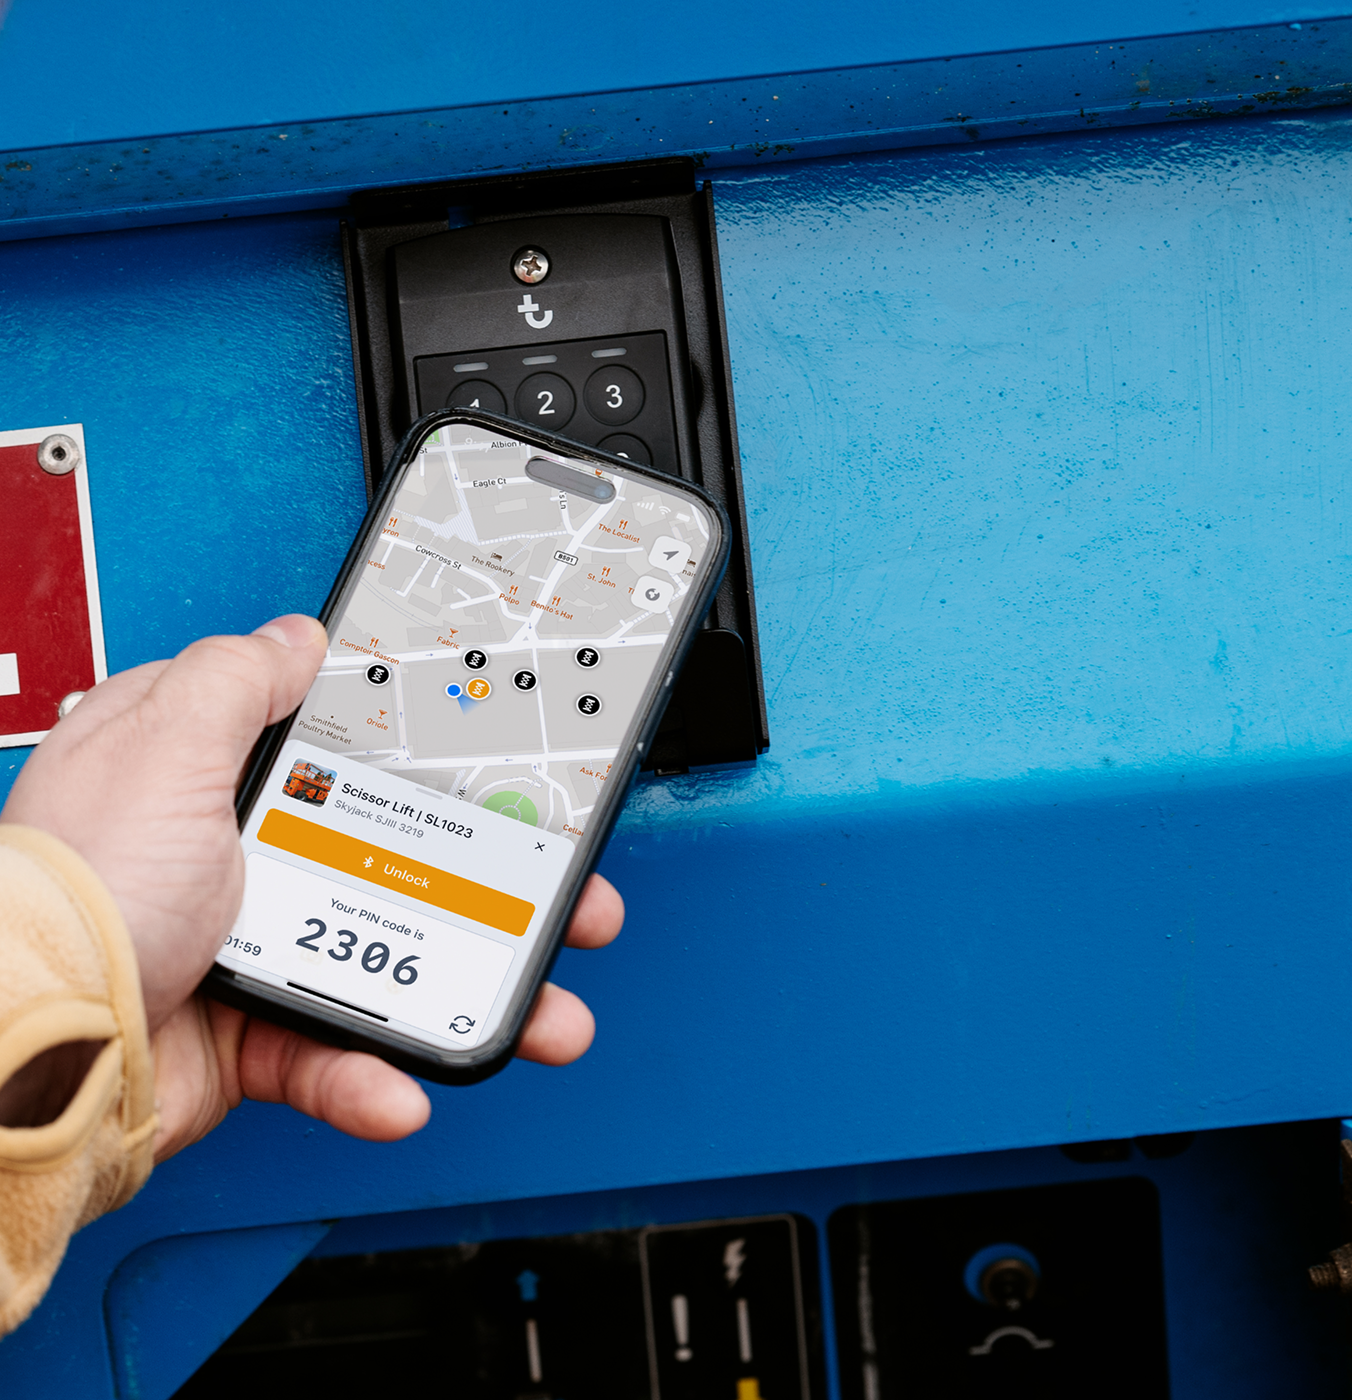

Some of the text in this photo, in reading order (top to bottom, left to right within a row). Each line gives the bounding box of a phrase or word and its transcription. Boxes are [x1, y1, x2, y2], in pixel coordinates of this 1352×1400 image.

[537, 384, 623, 415] 2 3
[491, 441, 517, 449] Albion
[473, 477, 507, 488] Eagle Ct
[598, 523, 640, 543] The Localist
[415, 544, 462, 570] Cowcross St
[471, 555, 515, 577] The Rookery
[587, 573, 616, 588] St. John
[499, 593, 520, 605] Polpo
[530, 600, 574, 620] Benito's Hat
[339, 638, 400, 665] Comptoir Gascon
[436, 636, 460, 650] Fabric
[298, 720, 352, 745] Poultry Market
[310, 714, 348, 733] Smithfield
[366, 717, 389, 731] Oriole
[579, 766, 593, 777] Ask
[334, 799, 373, 820] Skyjack
[398, 823, 425, 838] 3219
[341, 782, 390, 808] Scissor
[391, 801, 416, 818] Lift
[424, 813, 474, 839] SL1023
[384, 863, 430, 889] Unlock
[331, 898, 425, 941] Your PIN code is
[295, 917, 421, 985] 2306
